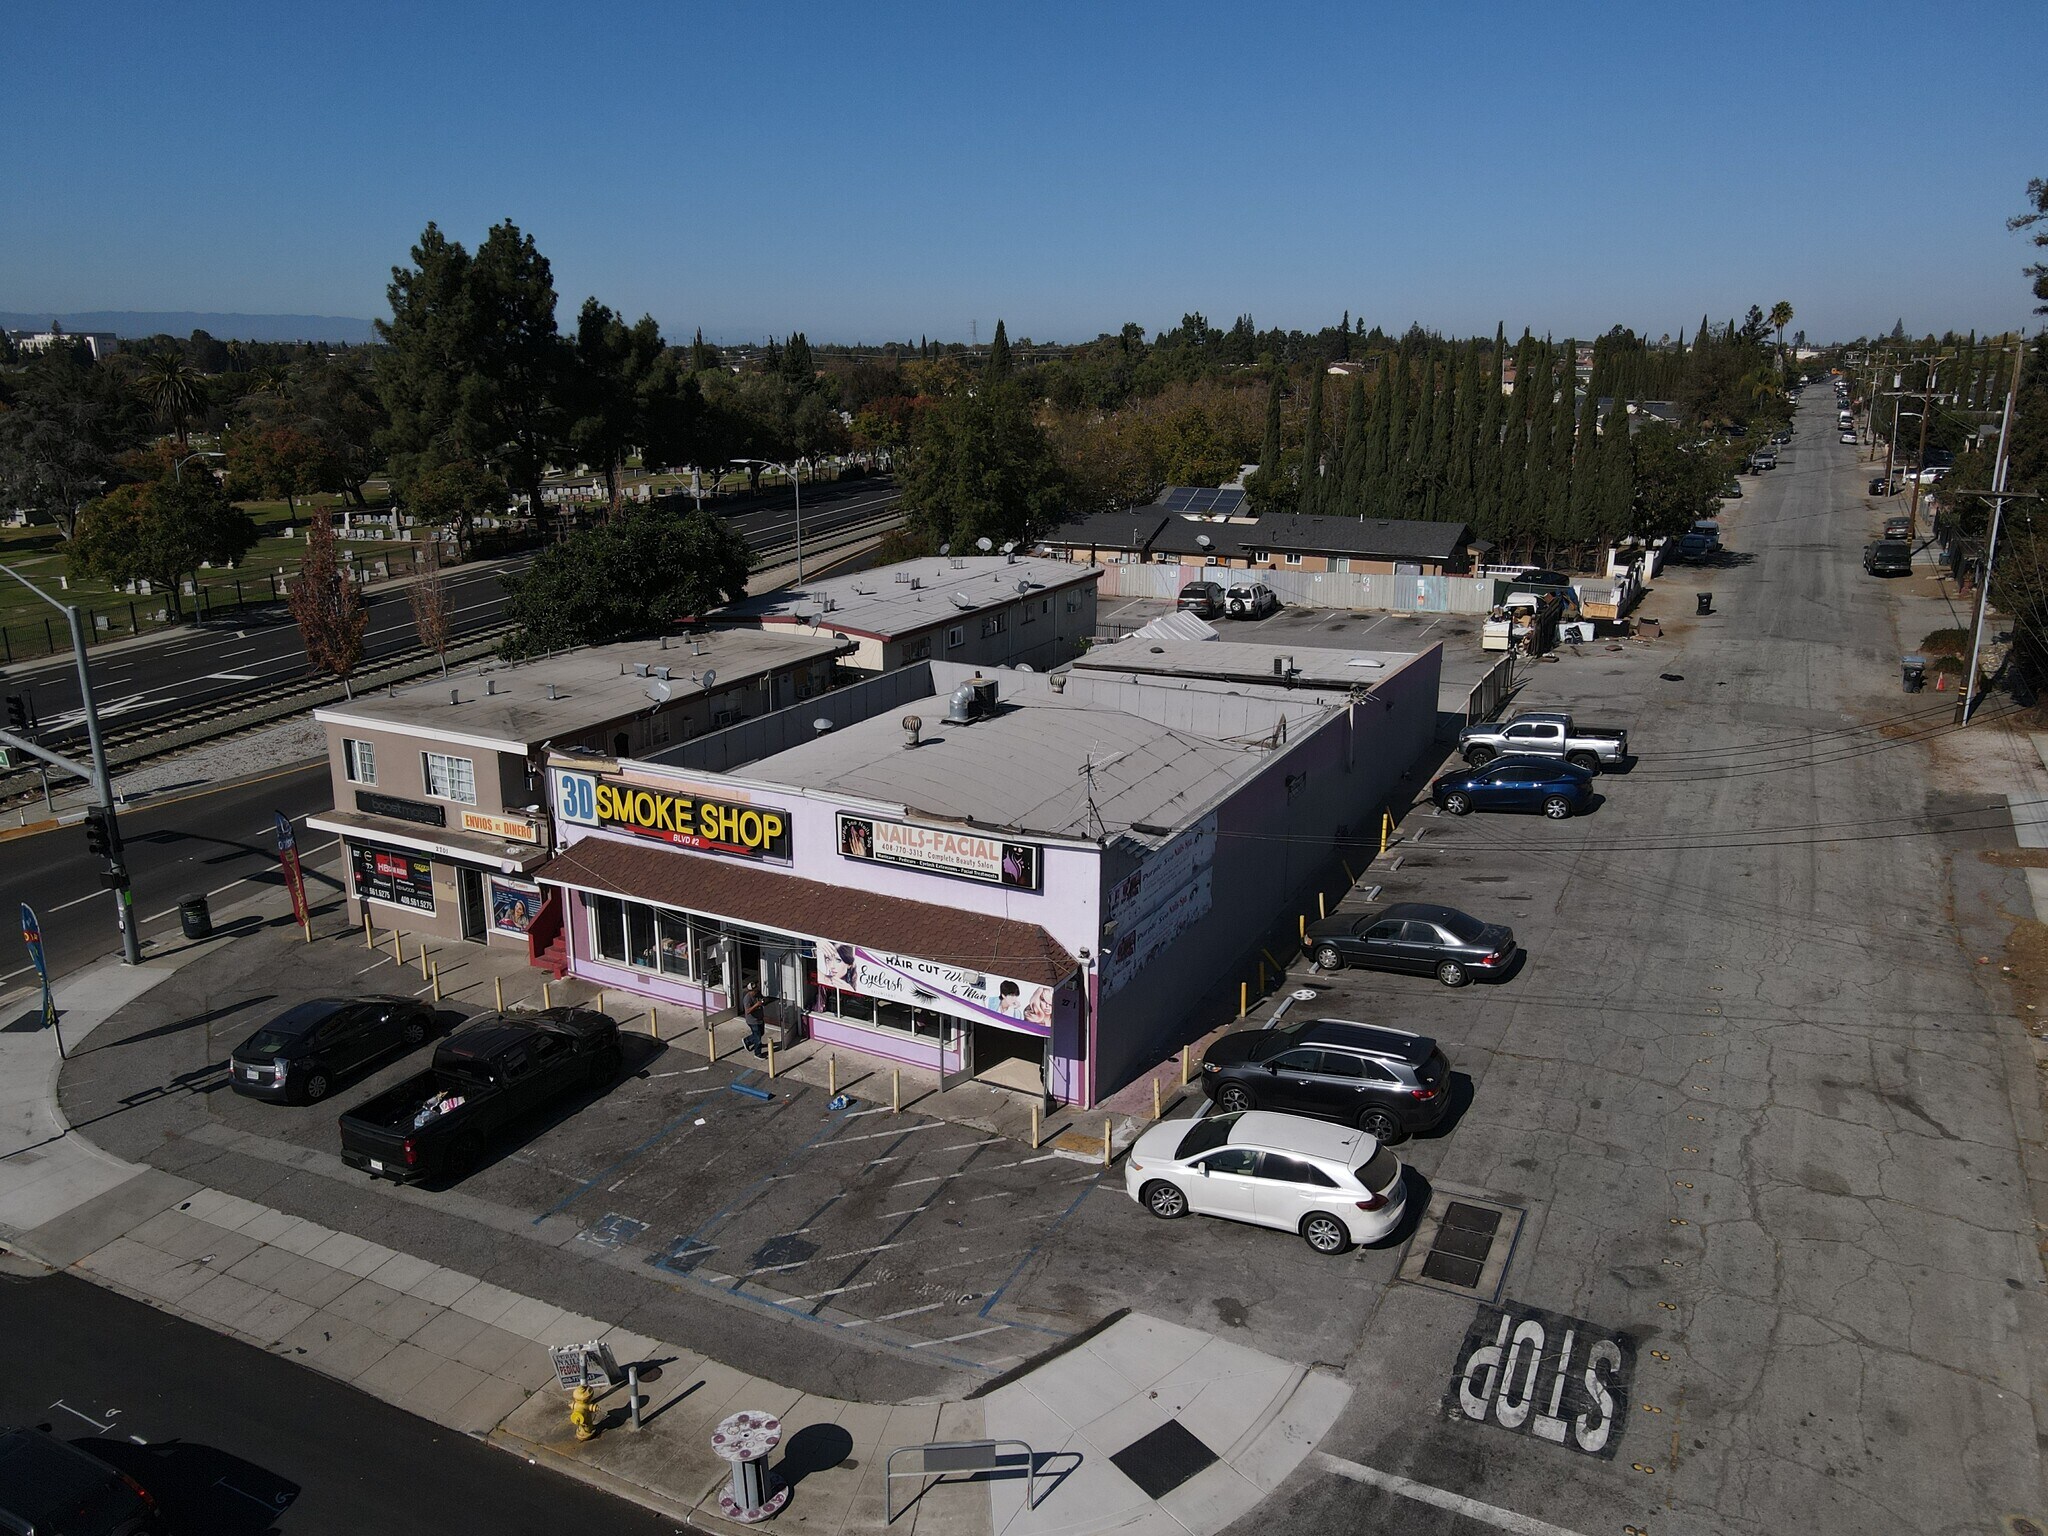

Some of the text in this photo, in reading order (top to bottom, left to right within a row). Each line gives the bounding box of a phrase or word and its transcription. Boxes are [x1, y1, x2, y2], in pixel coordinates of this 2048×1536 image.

[562, 776, 594, 819] 3D
[465, 815, 492, 831] ENVIOS
[503, 822, 532, 839] DINERO
[596, 784, 782, 849] SMOKE SHOP
[673, 834, 700, 846] BLVD #2
[876, 823, 1000, 861] NAILS-FACIAL
[882, 843, 994, 870] 408-770-3313 Complete Beauty Salon
[859, 964, 905, 992] Eyelash
[886, 955, 913, 970] HAIR
[918, 963, 940, 975] CUT
[1459, 1315, 1621, 1452] STOP
